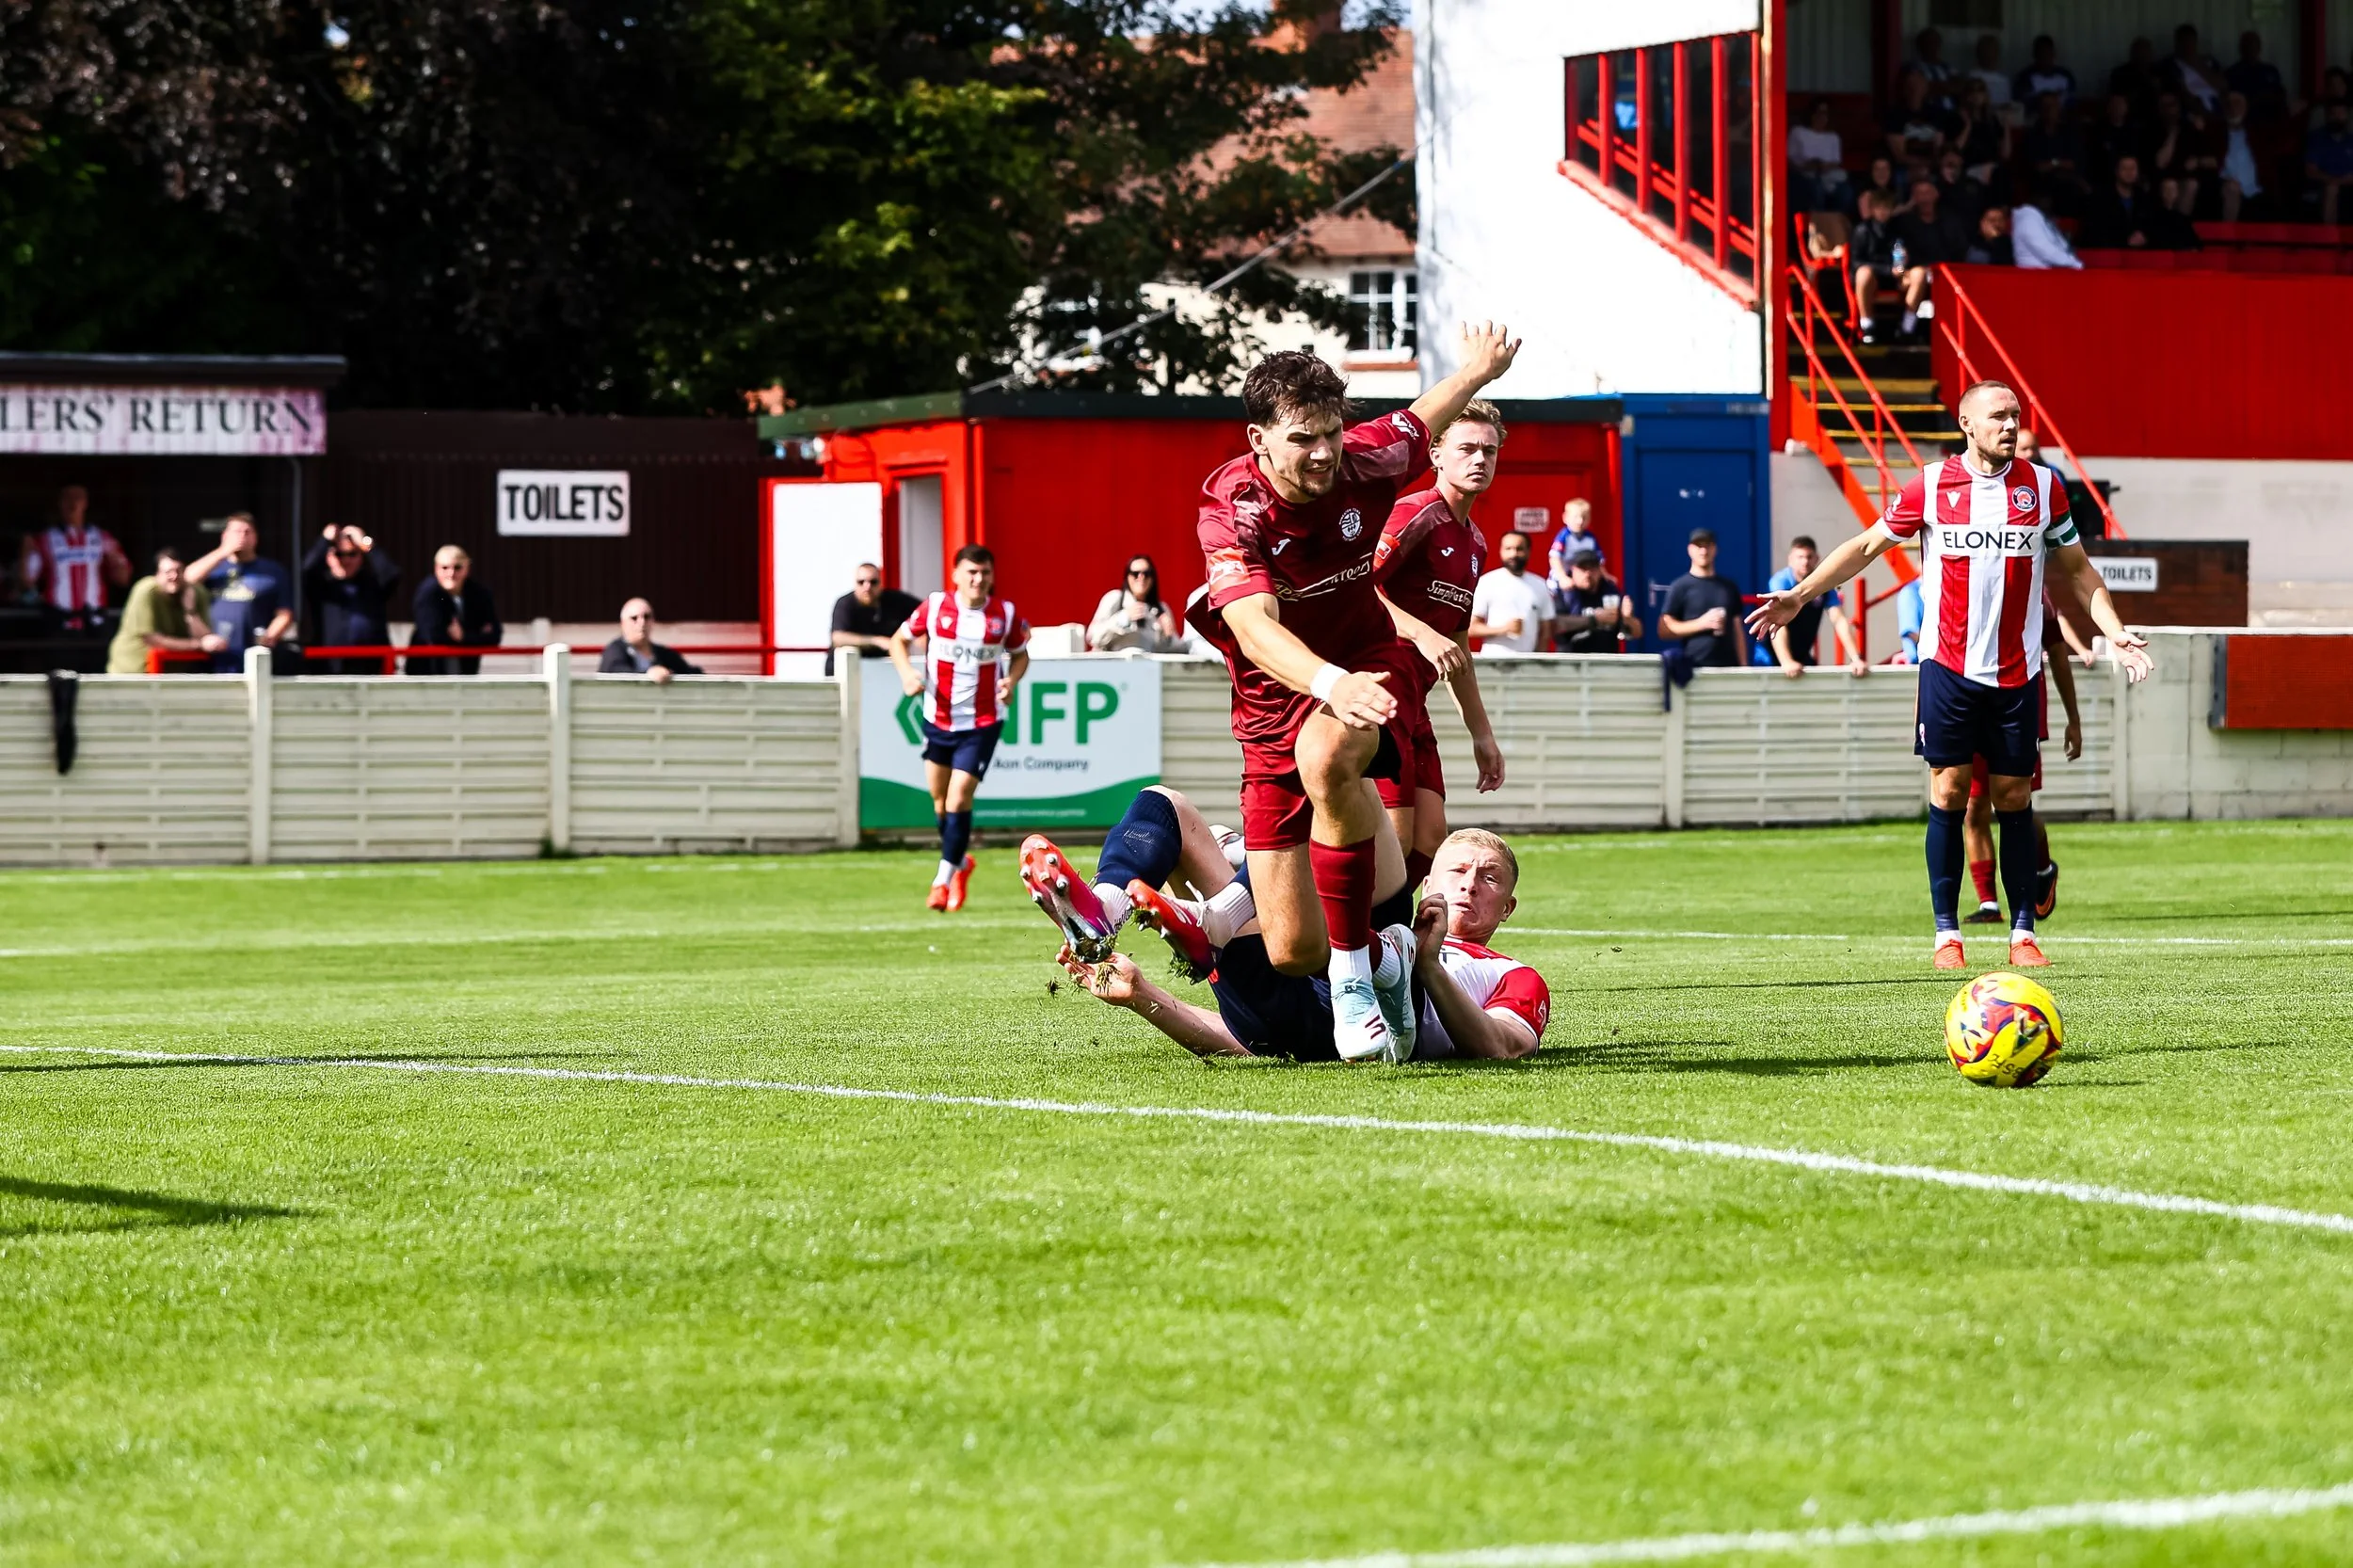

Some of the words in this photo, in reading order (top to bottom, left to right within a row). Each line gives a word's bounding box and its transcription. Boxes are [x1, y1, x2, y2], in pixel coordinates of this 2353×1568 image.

[129, 395, 314, 435] RETURN
[504, 484, 624, 521] TOILETS
[1943, 531, 2034, 551] ELONEX
[2102, 567, 2152, 581] TOILETS
[1024, 757, 1089, 773] Company
